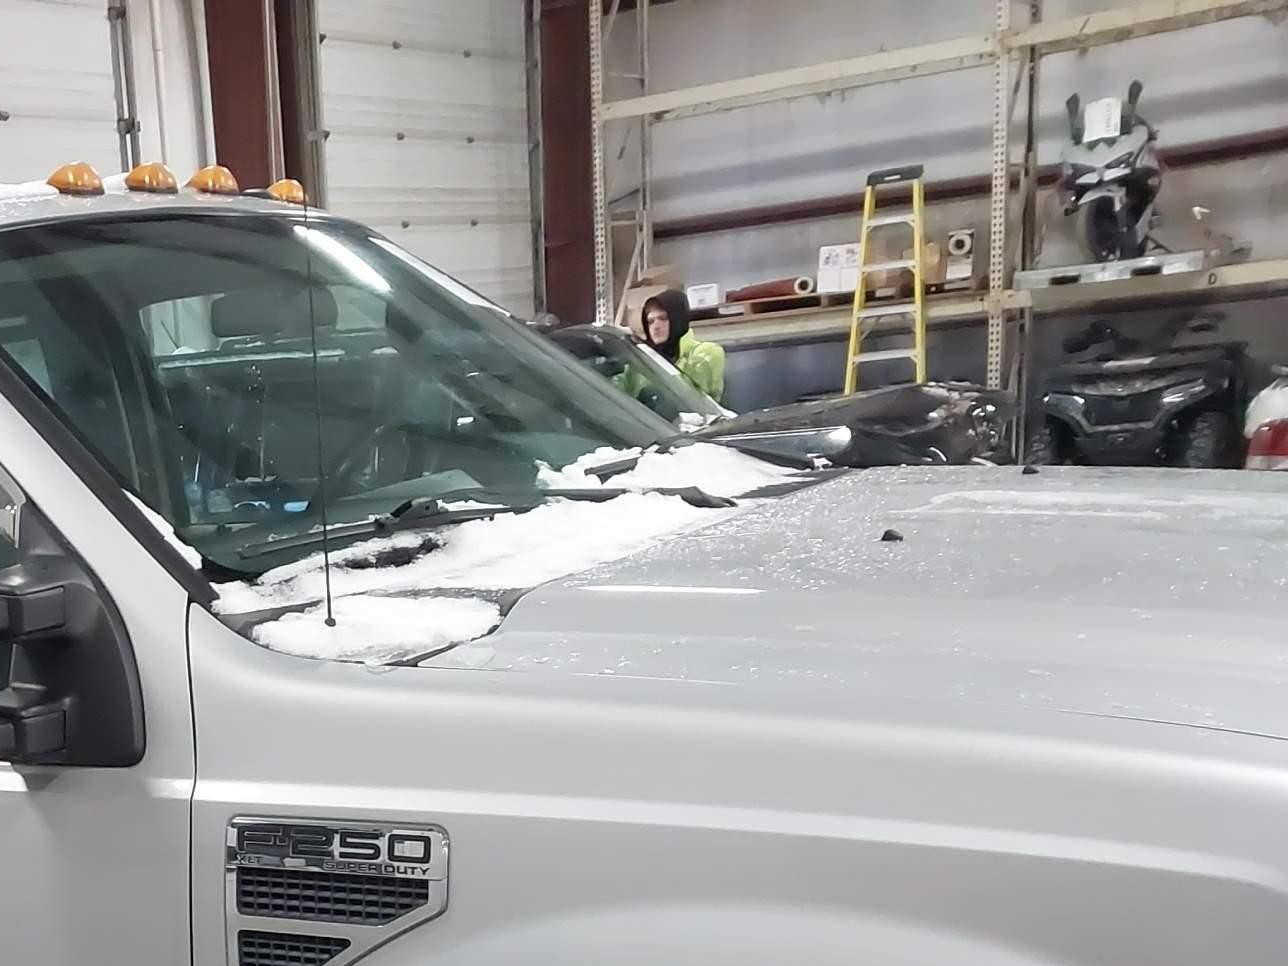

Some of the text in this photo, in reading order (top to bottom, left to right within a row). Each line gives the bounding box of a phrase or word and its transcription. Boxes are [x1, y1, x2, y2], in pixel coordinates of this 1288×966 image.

[236, 825, 432, 864] F-250
[235, 854, 264, 865] XLT
[322, 861, 430, 876] SUPER DUTY
